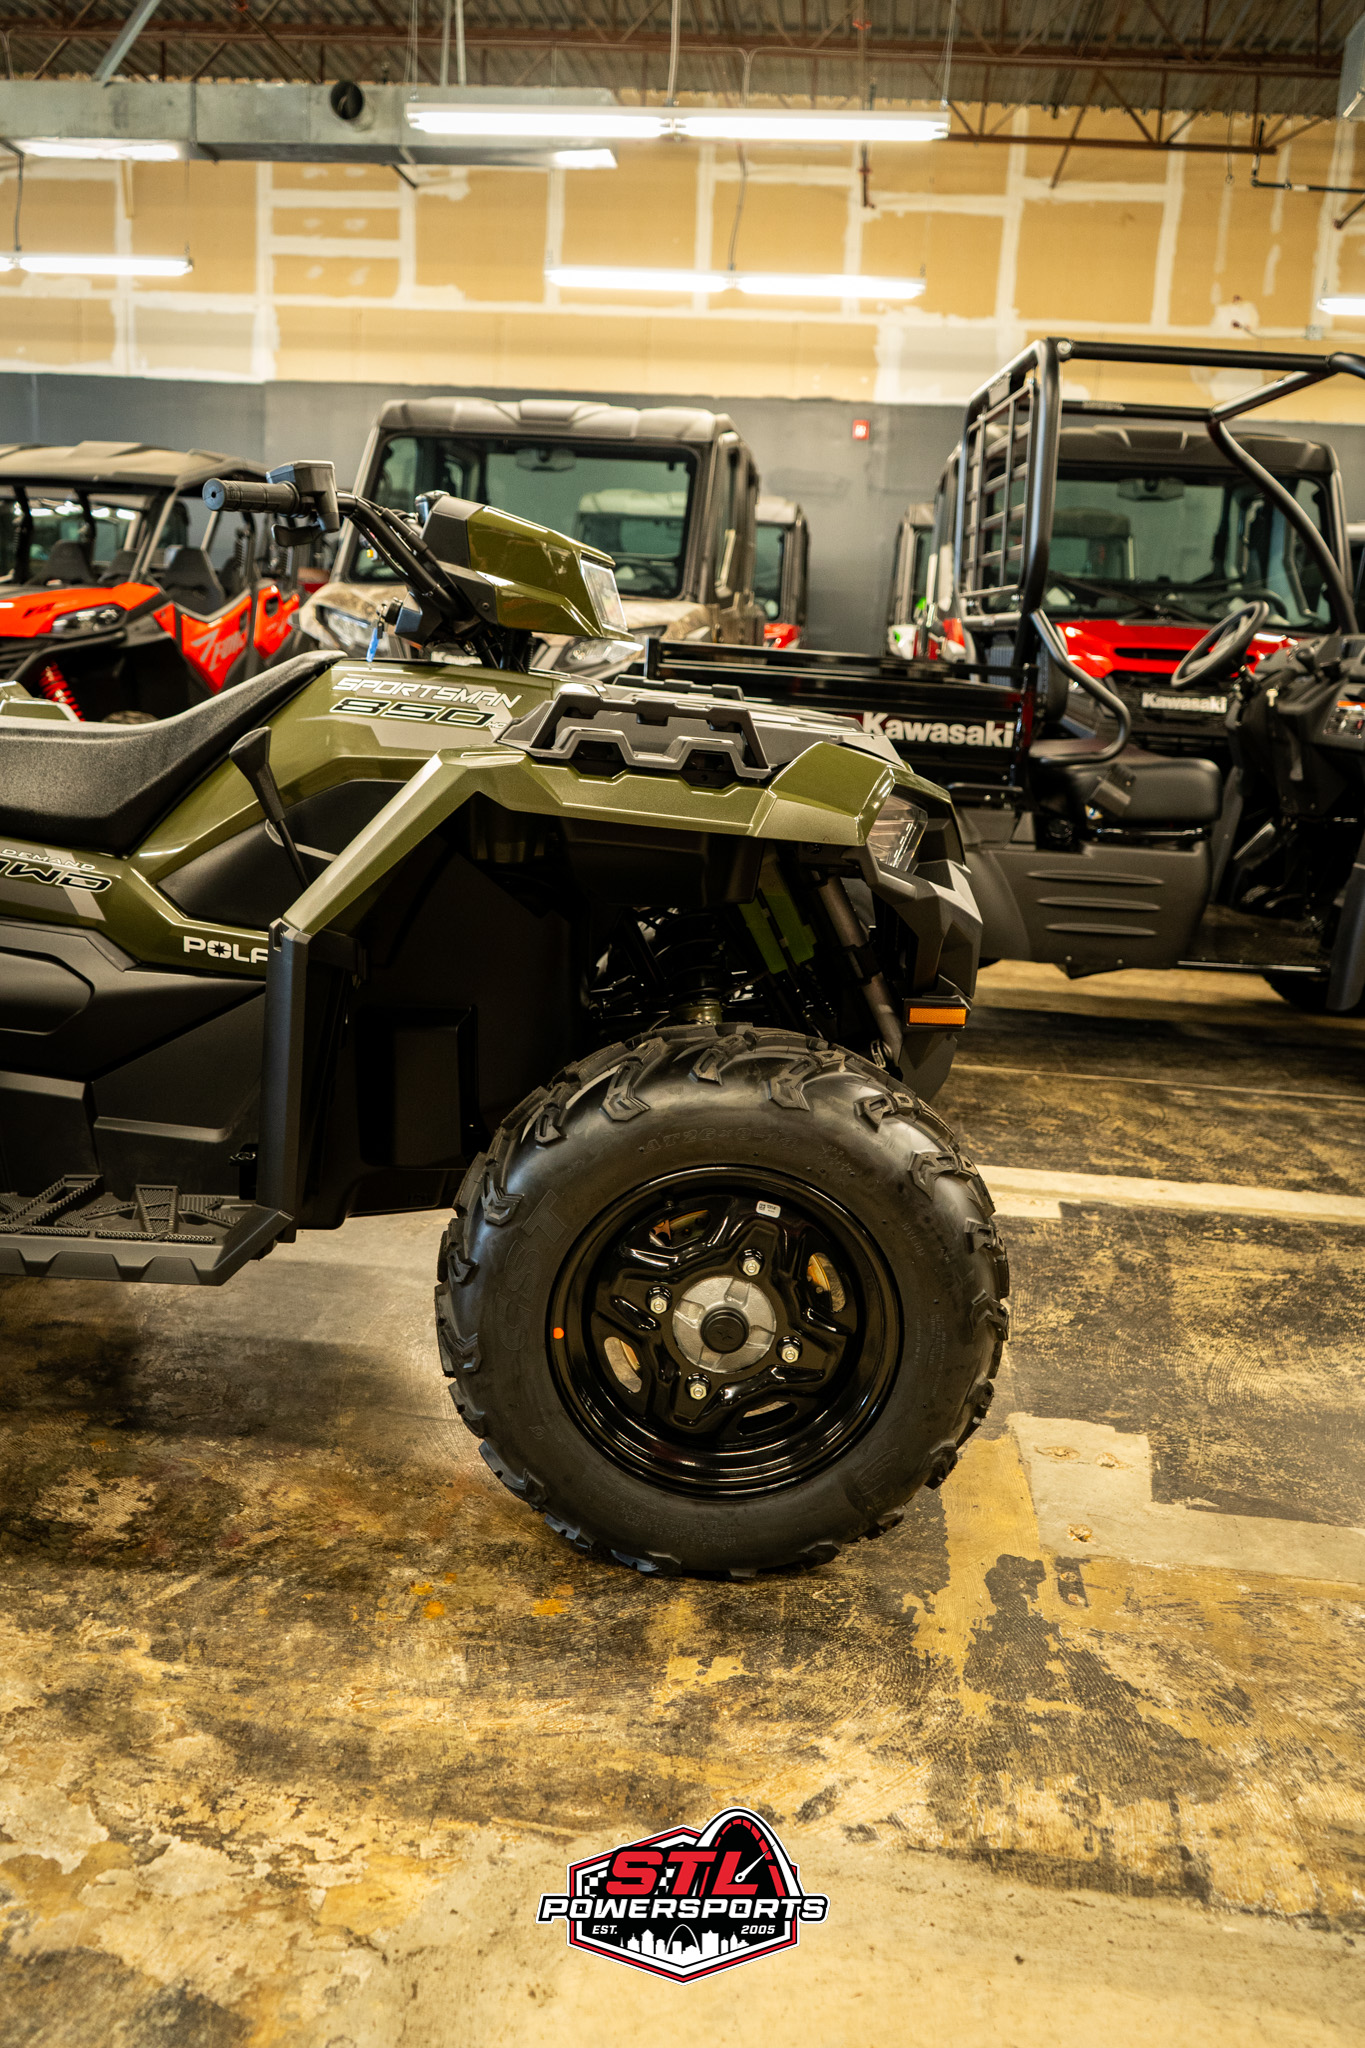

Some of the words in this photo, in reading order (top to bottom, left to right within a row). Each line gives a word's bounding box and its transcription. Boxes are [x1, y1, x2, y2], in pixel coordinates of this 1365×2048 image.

[332, 677, 522, 708] SPORTSMAN
[1142, 692, 1228, 713] Kawasaki
[330, 697, 496, 728] 850
[863, 711, 1015, 748] Kawasaki
[2, 848, 96, 870] DEMAND
